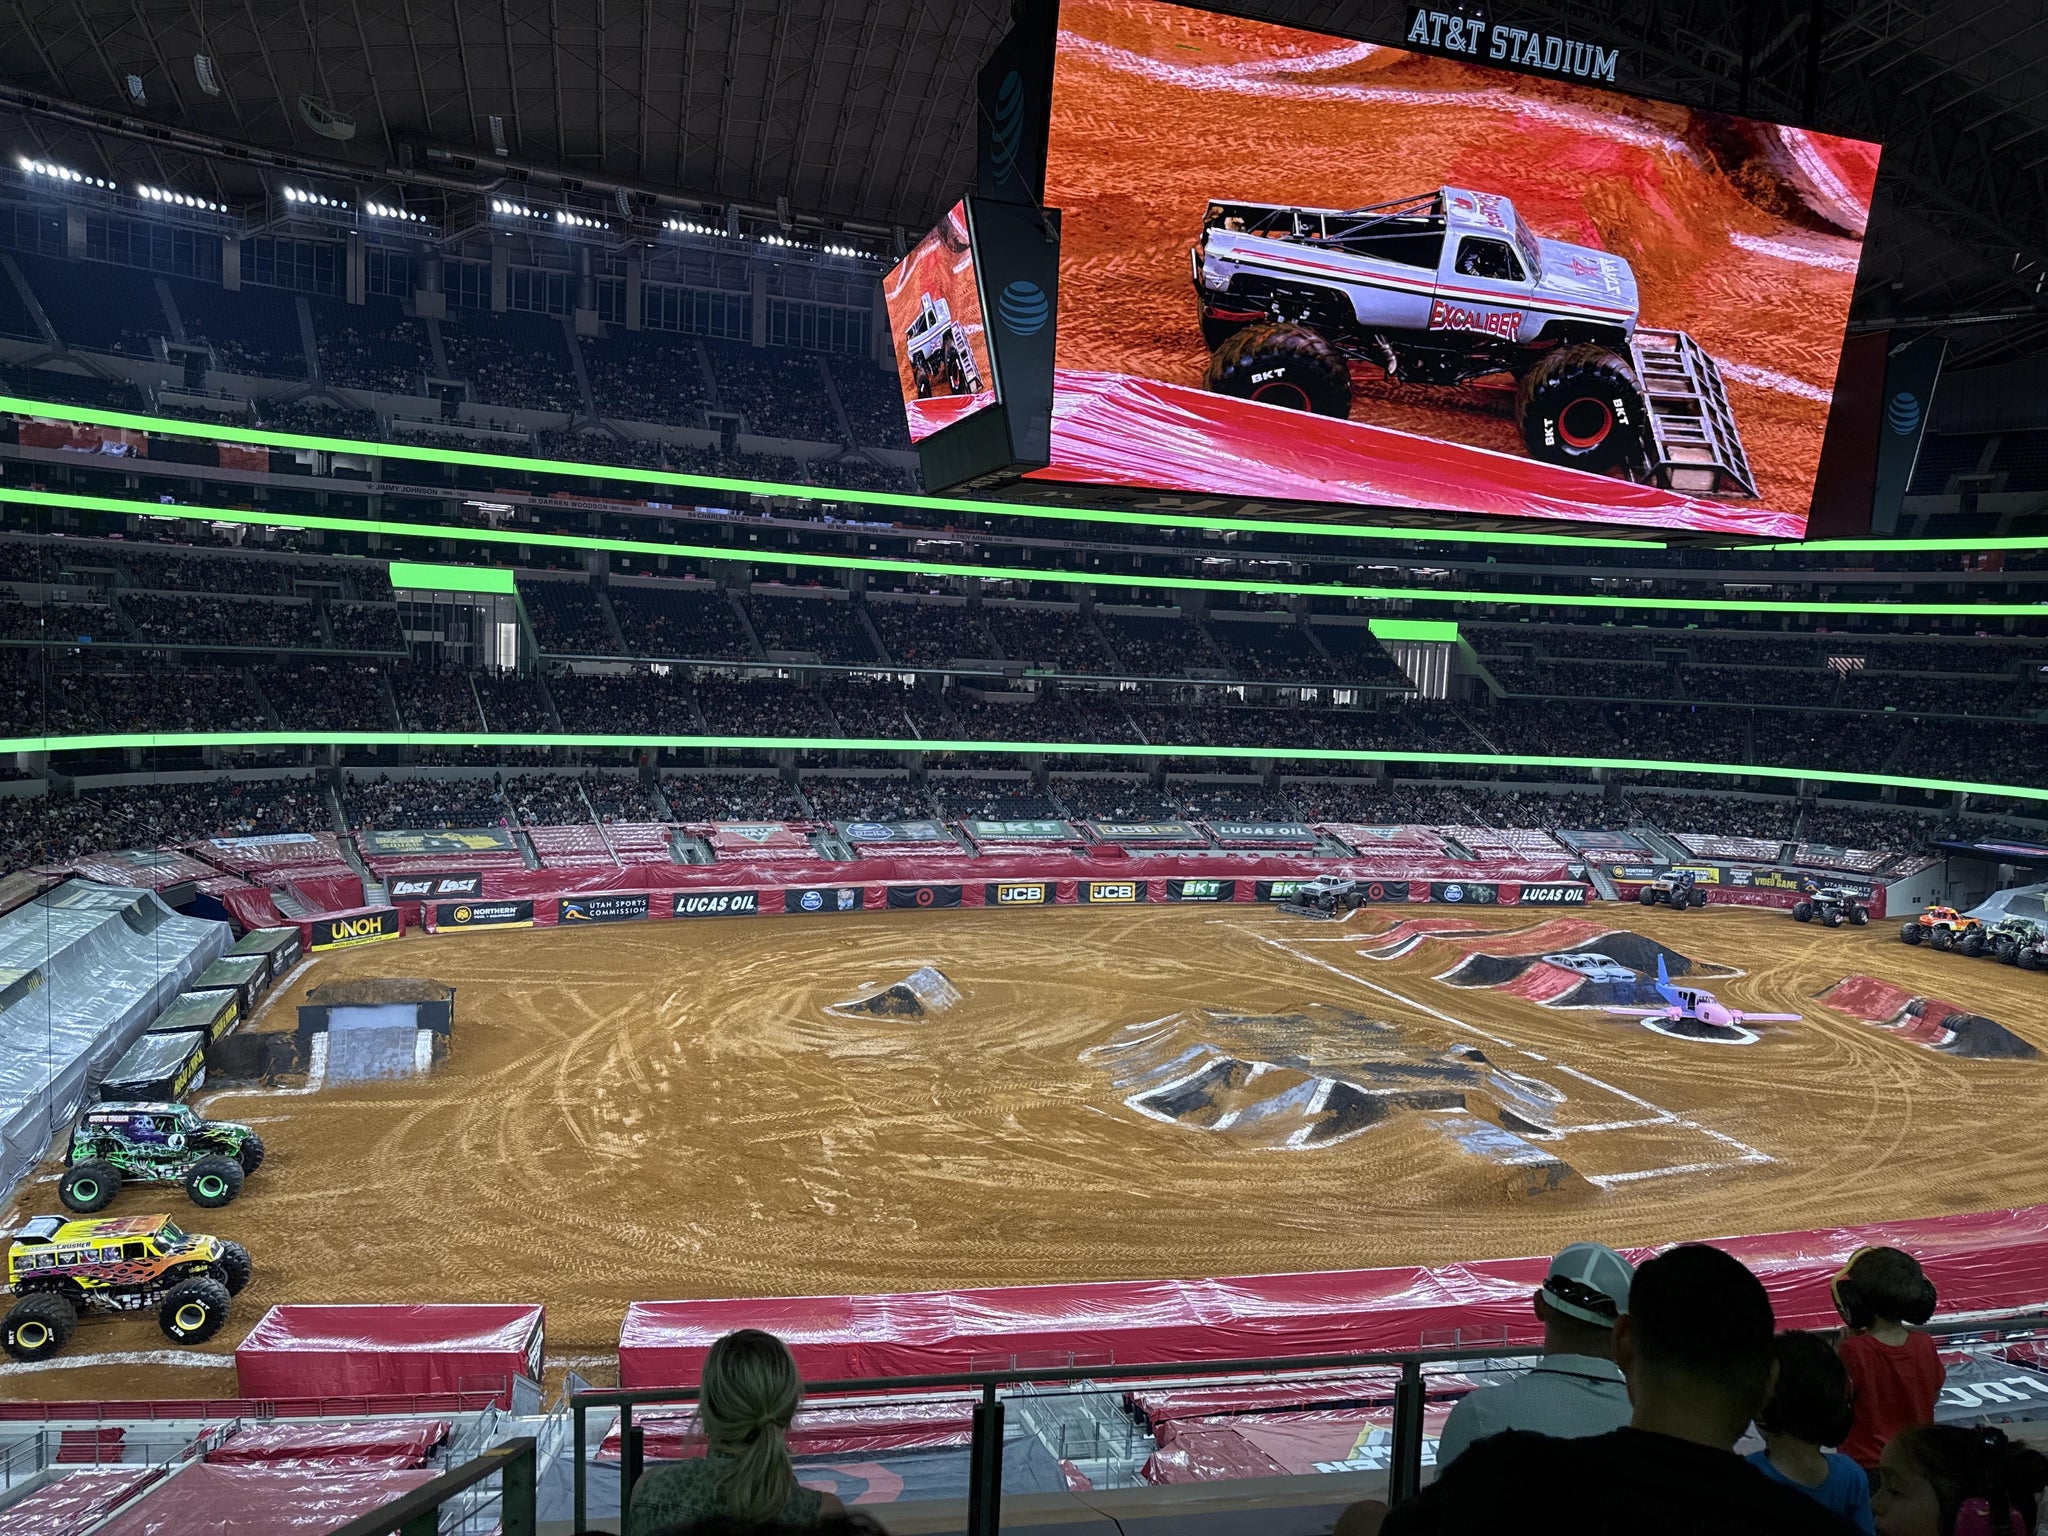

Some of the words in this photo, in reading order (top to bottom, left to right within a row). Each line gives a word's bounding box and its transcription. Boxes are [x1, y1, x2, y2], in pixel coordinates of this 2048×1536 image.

[1407, 9, 1485, 54] AT&T
[1490, 25, 1619, 82] STADIUM
[1430, 299, 1522, 342] EXCALIBER
[1251, 367, 1286, 384] BKT
[1613, 398, 1629, 426] BKT
[1544, 418, 1555, 447] BKT
[376, 484, 399, 492] JIMMY
[401, 486, 438, 496] JOHNSON
[538, 498, 569, 506] DARREN
[571, 501, 608, 510] WOODSON
[979, 822, 1056, 832] BKT
[1104, 825, 1152, 833] JCB
[1220, 826, 1274, 835] LUCAS
[1278, 827, 1306, 835] OIL
[1771, 872, 1782, 880] THE
[1183, 883, 1219, 893] BKT
[1754, 877, 1775, 886] VIDEO
[1776, 879, 1798, 889] GAME
[1002, 887, 1041, 900] JCB
[1094, 886, 1132, 898] JCB
[1522, 889, 1563, 901] LUCAS
[1564, 889, 1585, 901] OIL
[590, 901, 612, 909] UTAH
[615, 900, 647, 908] SPORTS
[676, 895, 729, 912] LUCAS
[730, 896, 754, 910] OIL
[473, 908, 515, 916] NORTHERN
[590, 907, 646, 917] COMMISSION
[332, 917, 382, 939] UNOH
[56, 1242, 91, 1250] CRUSHER
[195, 1298, 210, 1311] BKT
[169, 1325, 185, 1338] BKT
